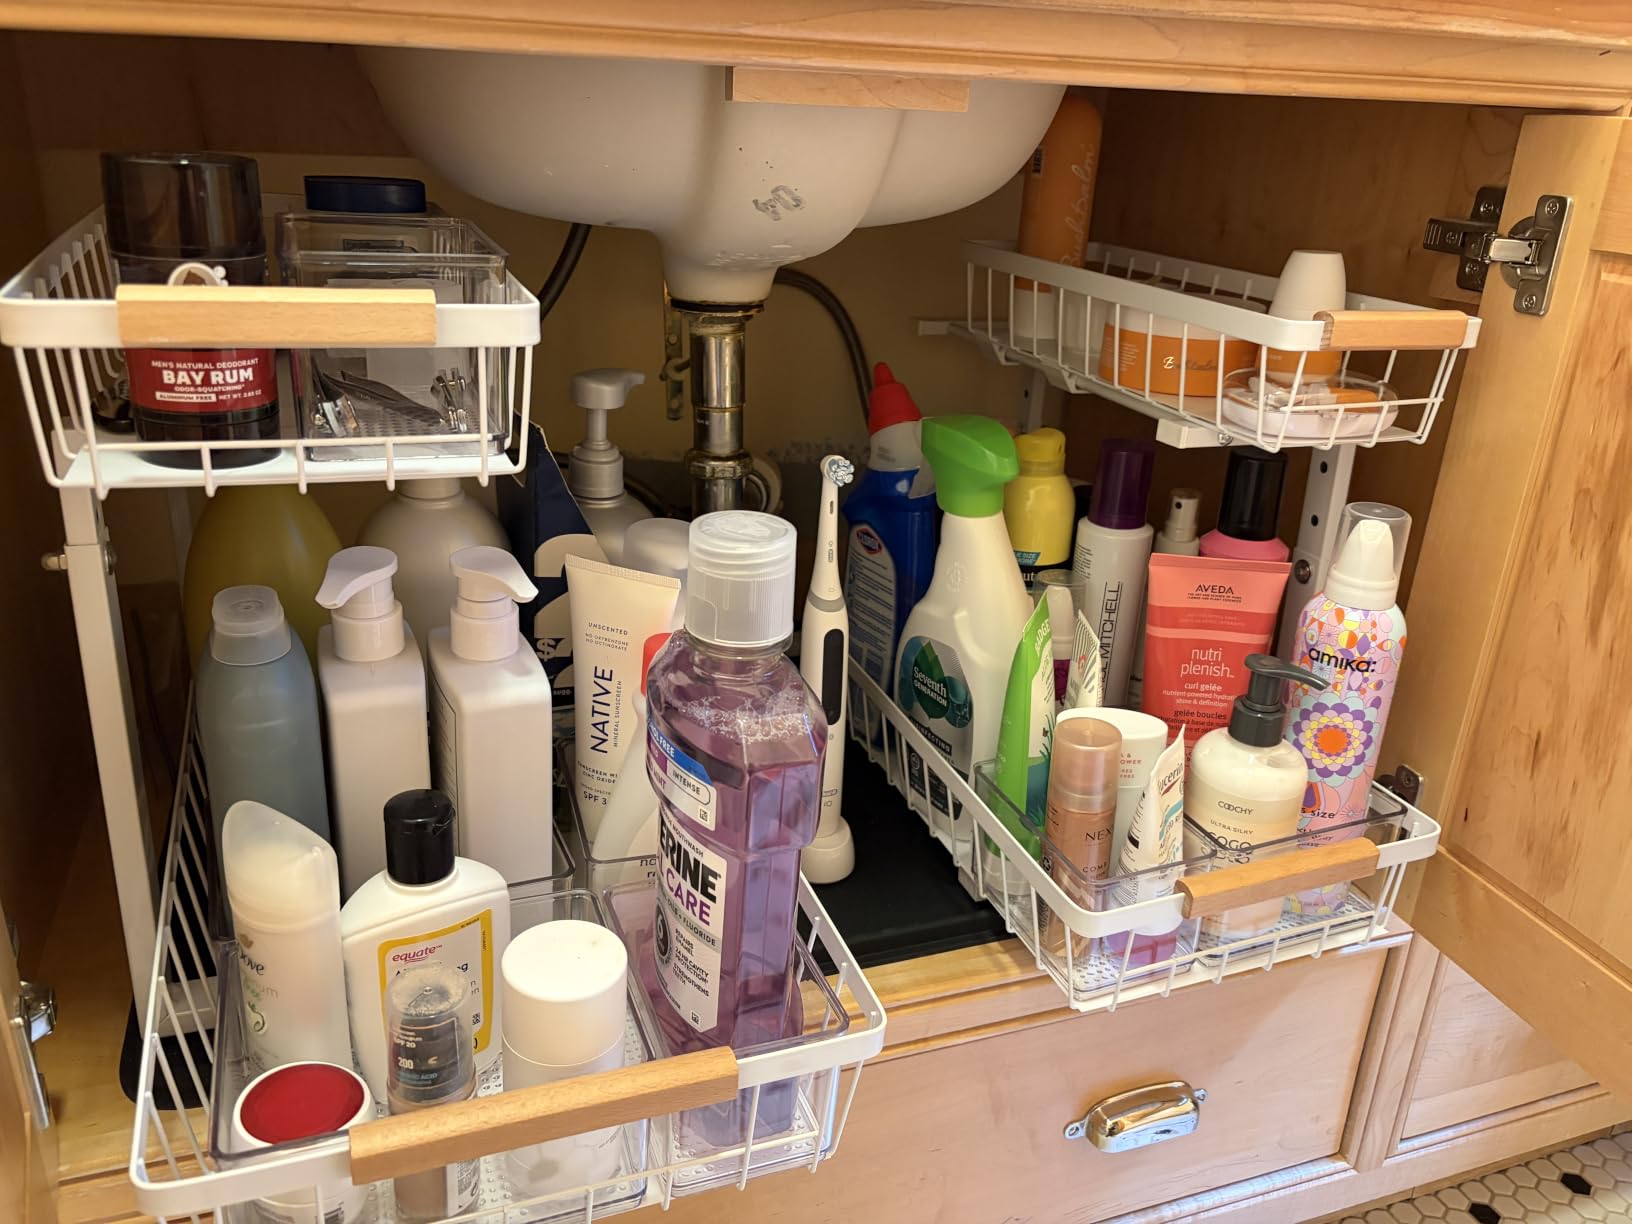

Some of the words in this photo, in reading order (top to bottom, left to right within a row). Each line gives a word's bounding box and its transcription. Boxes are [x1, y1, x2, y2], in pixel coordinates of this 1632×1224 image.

[175, 361, 214, 369] NATURAL
[216, 358, 259, 369] DEODORANT
[162, 369, 205, 385] BAY
[210, 367, 254, 385] RUM
[1195, 584, 1234, 595] AVEDA
[588, 622, 628, 636] UNSCENTED
[1100, 581, 1120, 659] MITCHELL
[1191, 647, 1222, 662] nutri
[1180, 661, 1230, 678] plenish
[913, 666, 947, 698] Seventh
[1184, 681, 1199, 689] curl
[913, 679, 947, 707] GENERATION
[590, 665, 613, 754] NATIVE
[1196, 711, 1226, 720] boucles
[660, 736, 675, 758] FREE
[672, 769, 701, 795] INTENSE
[583, 791, 599, 802] SPF
[1217, 800, 1253, 815] COOCHY
[1310, 808, 1336, 819] size
[1210, 819, 1231, 831] ULTRA
[1232, 827, 1254, 835] SILKY
[672, 823, 704, 858] MOUTHWASH
[666, 867, 711, 927] CARE
[675, 928, 694, 950] REPAIRS
[682, 917, 716, 947] FLUORIDE
[392, 945, 437, 963] equate
[688, 958, 709, 978] CAVITY
[673, 963, 709, 997] STRENGTHENS
